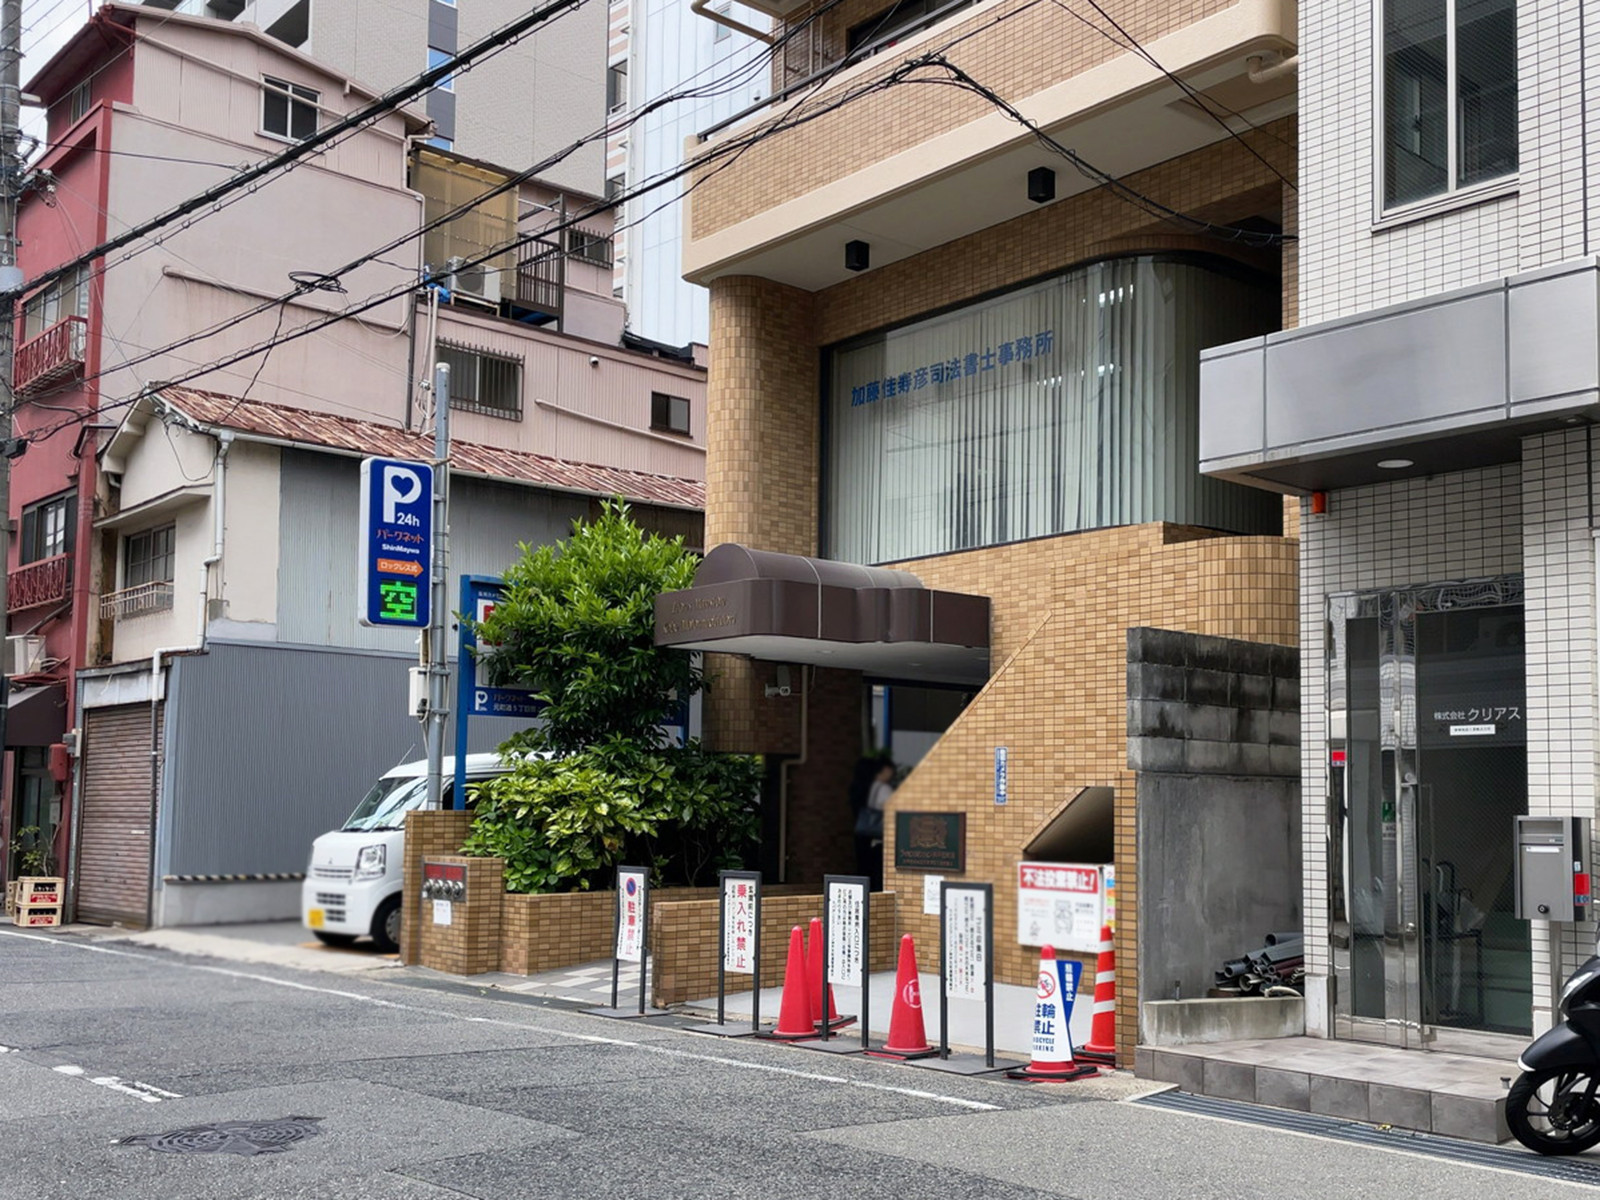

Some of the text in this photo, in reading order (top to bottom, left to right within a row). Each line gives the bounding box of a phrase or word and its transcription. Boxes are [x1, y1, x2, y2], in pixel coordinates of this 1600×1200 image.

[383, 465, 422, 524] P
[376, 528, 425, 545] パークネット
[397, 512, 420, 527] 24h
[382, 543, 420, 555] ShinMaywa
[380, 581, 417, 620] 空
[626, 901, 636, 955] 駐車禁止
[736, 884, 747, 969] 乗入れ禁止
